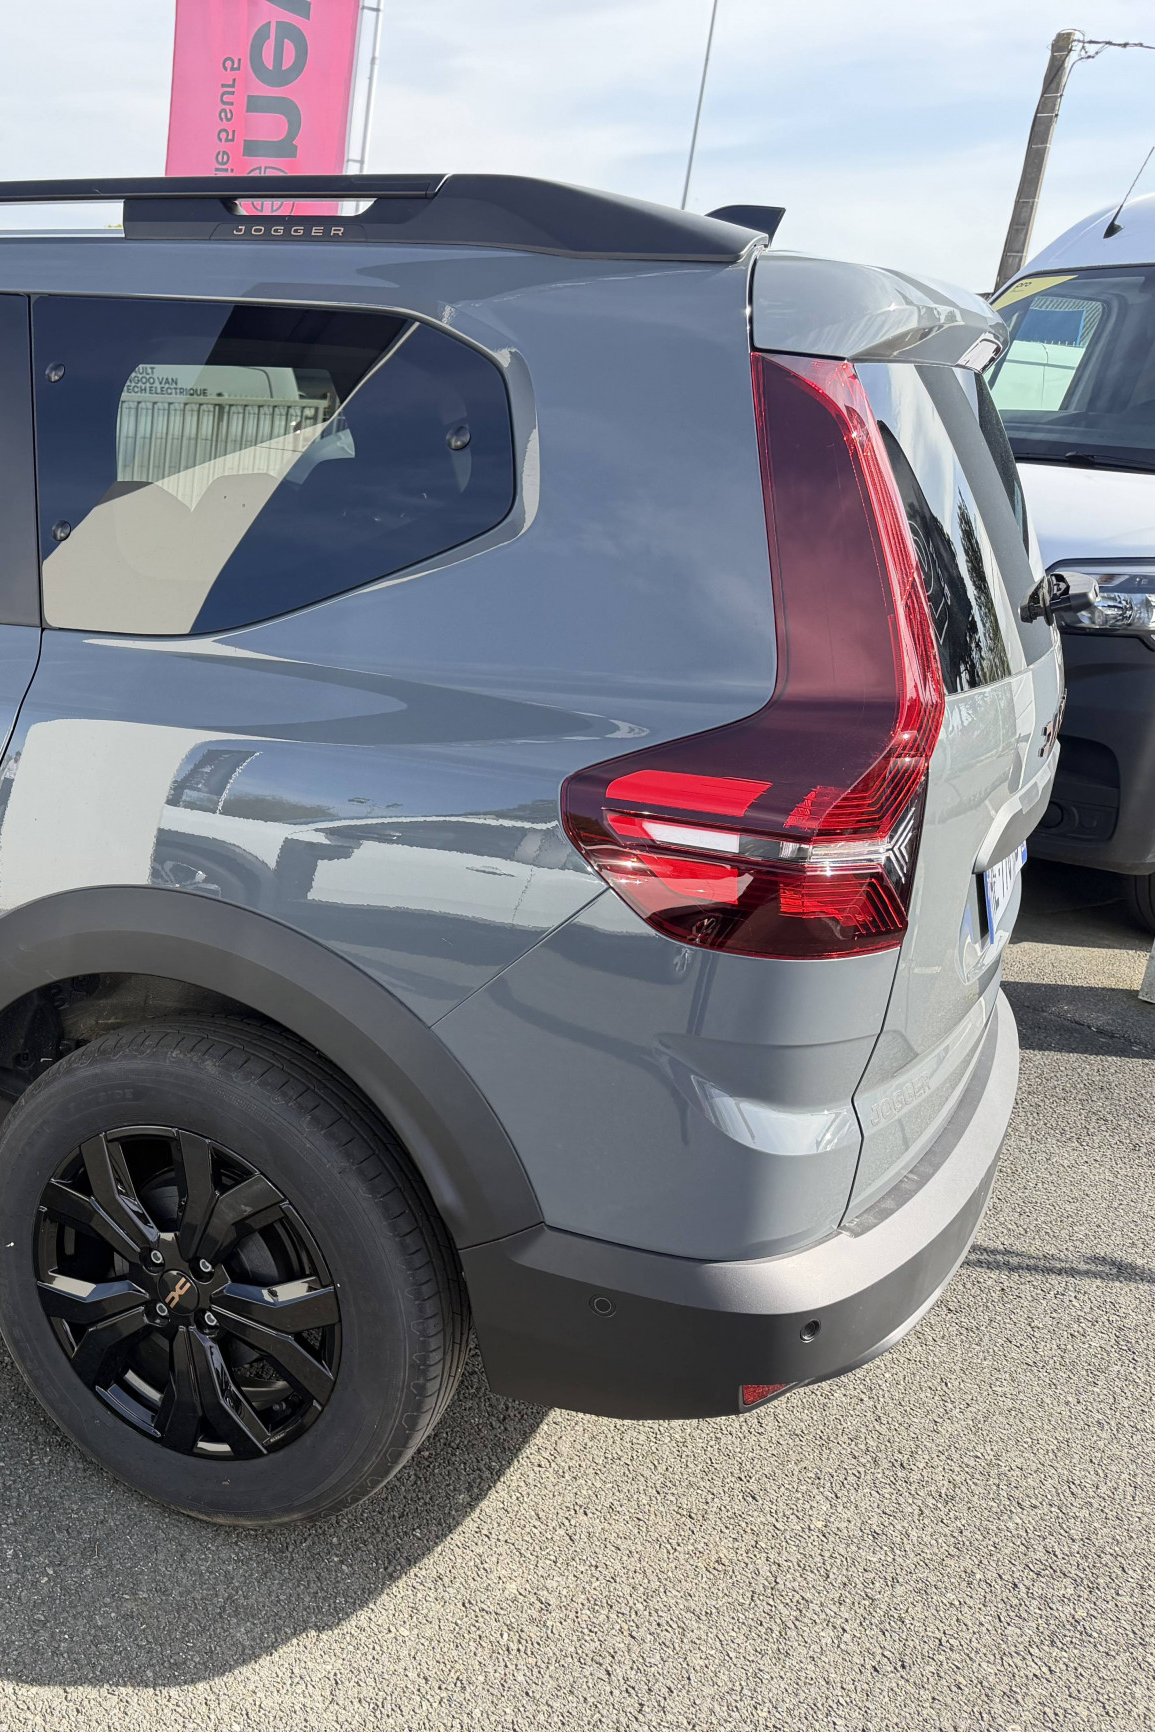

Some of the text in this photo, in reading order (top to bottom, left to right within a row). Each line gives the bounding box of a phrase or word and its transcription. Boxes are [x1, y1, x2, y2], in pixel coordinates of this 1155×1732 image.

[233, 225, 345, 236] JOGGER
[156, 376, 178, 386] VAN
[148, 386, 209, 397] ELECTRIQUE
